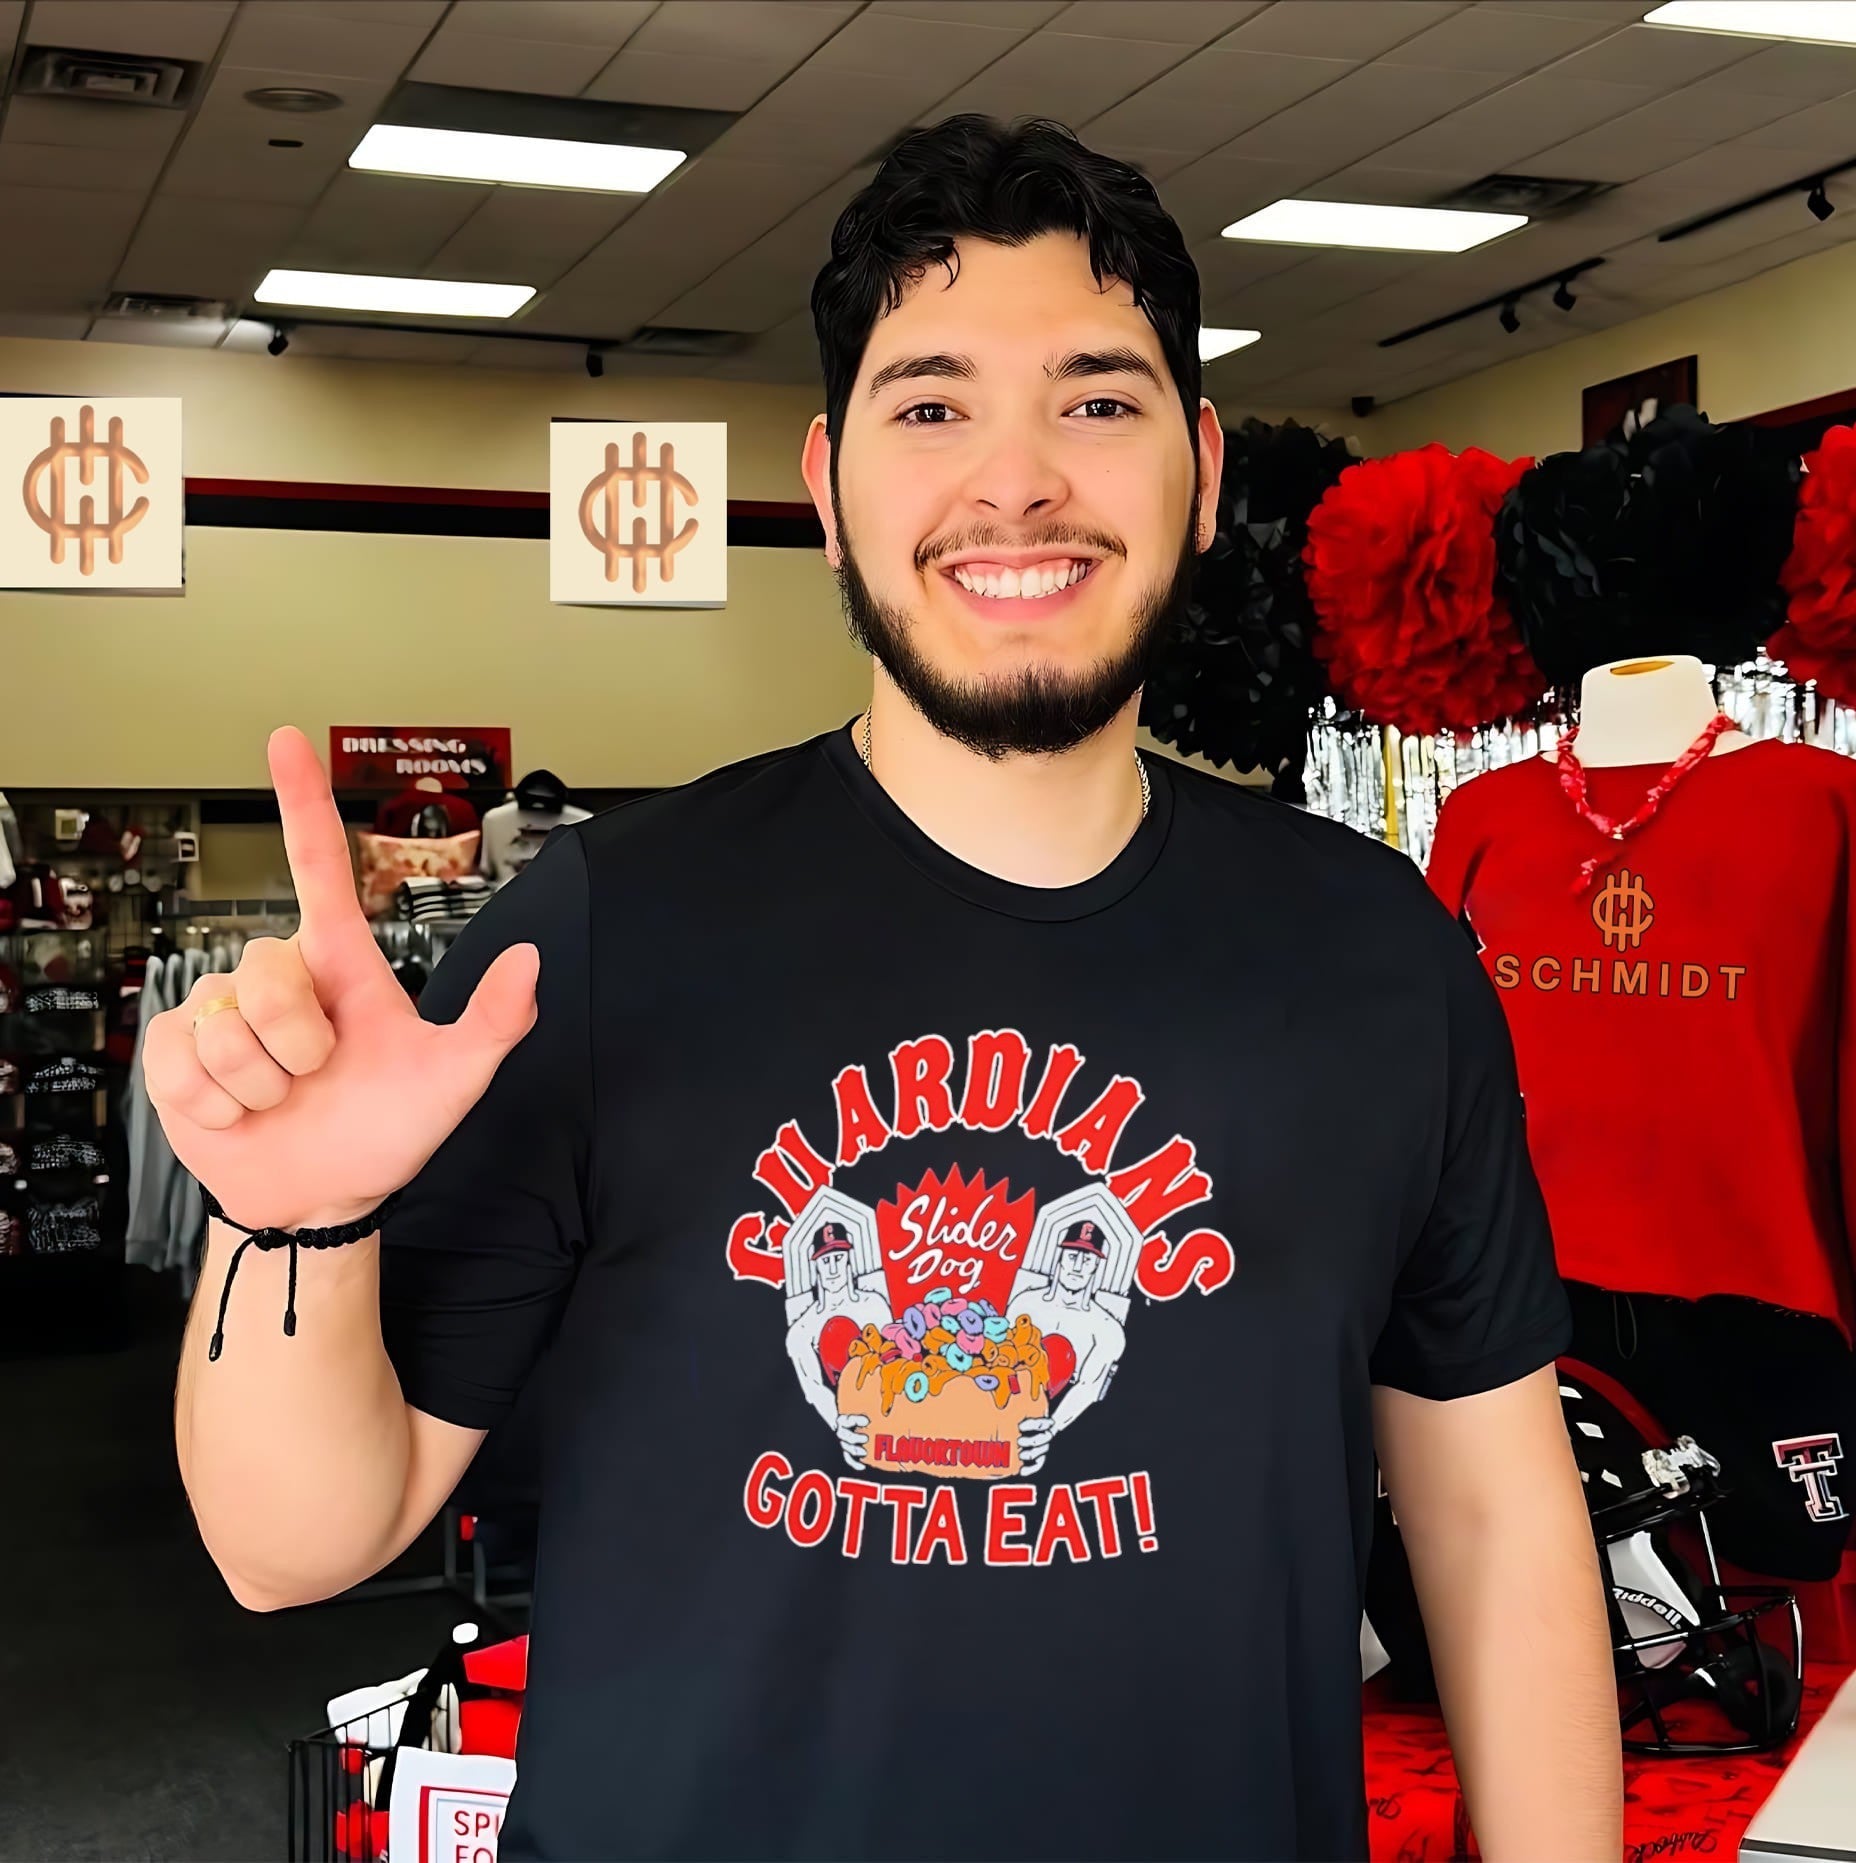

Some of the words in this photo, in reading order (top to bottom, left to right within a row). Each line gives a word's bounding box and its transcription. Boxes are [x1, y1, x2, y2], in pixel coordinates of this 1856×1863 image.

[342, 737, 467, 753] DRESSING
[396, 758, 487, 775] ROOMS
[1494, 954, 1747, 1001] SCHMIDT
[726, 1028, 1235, 1301] GUARDIANS
[888, 1194, 1018, 1261] Slider
[906, 1248, 984, 1295] Dog
[873, 1433, 1011, 1469] FLAVORTOWN
[744, 1451, 968, 1566] GOTTA
[984, 1471, 1159, 1567] EAT!
